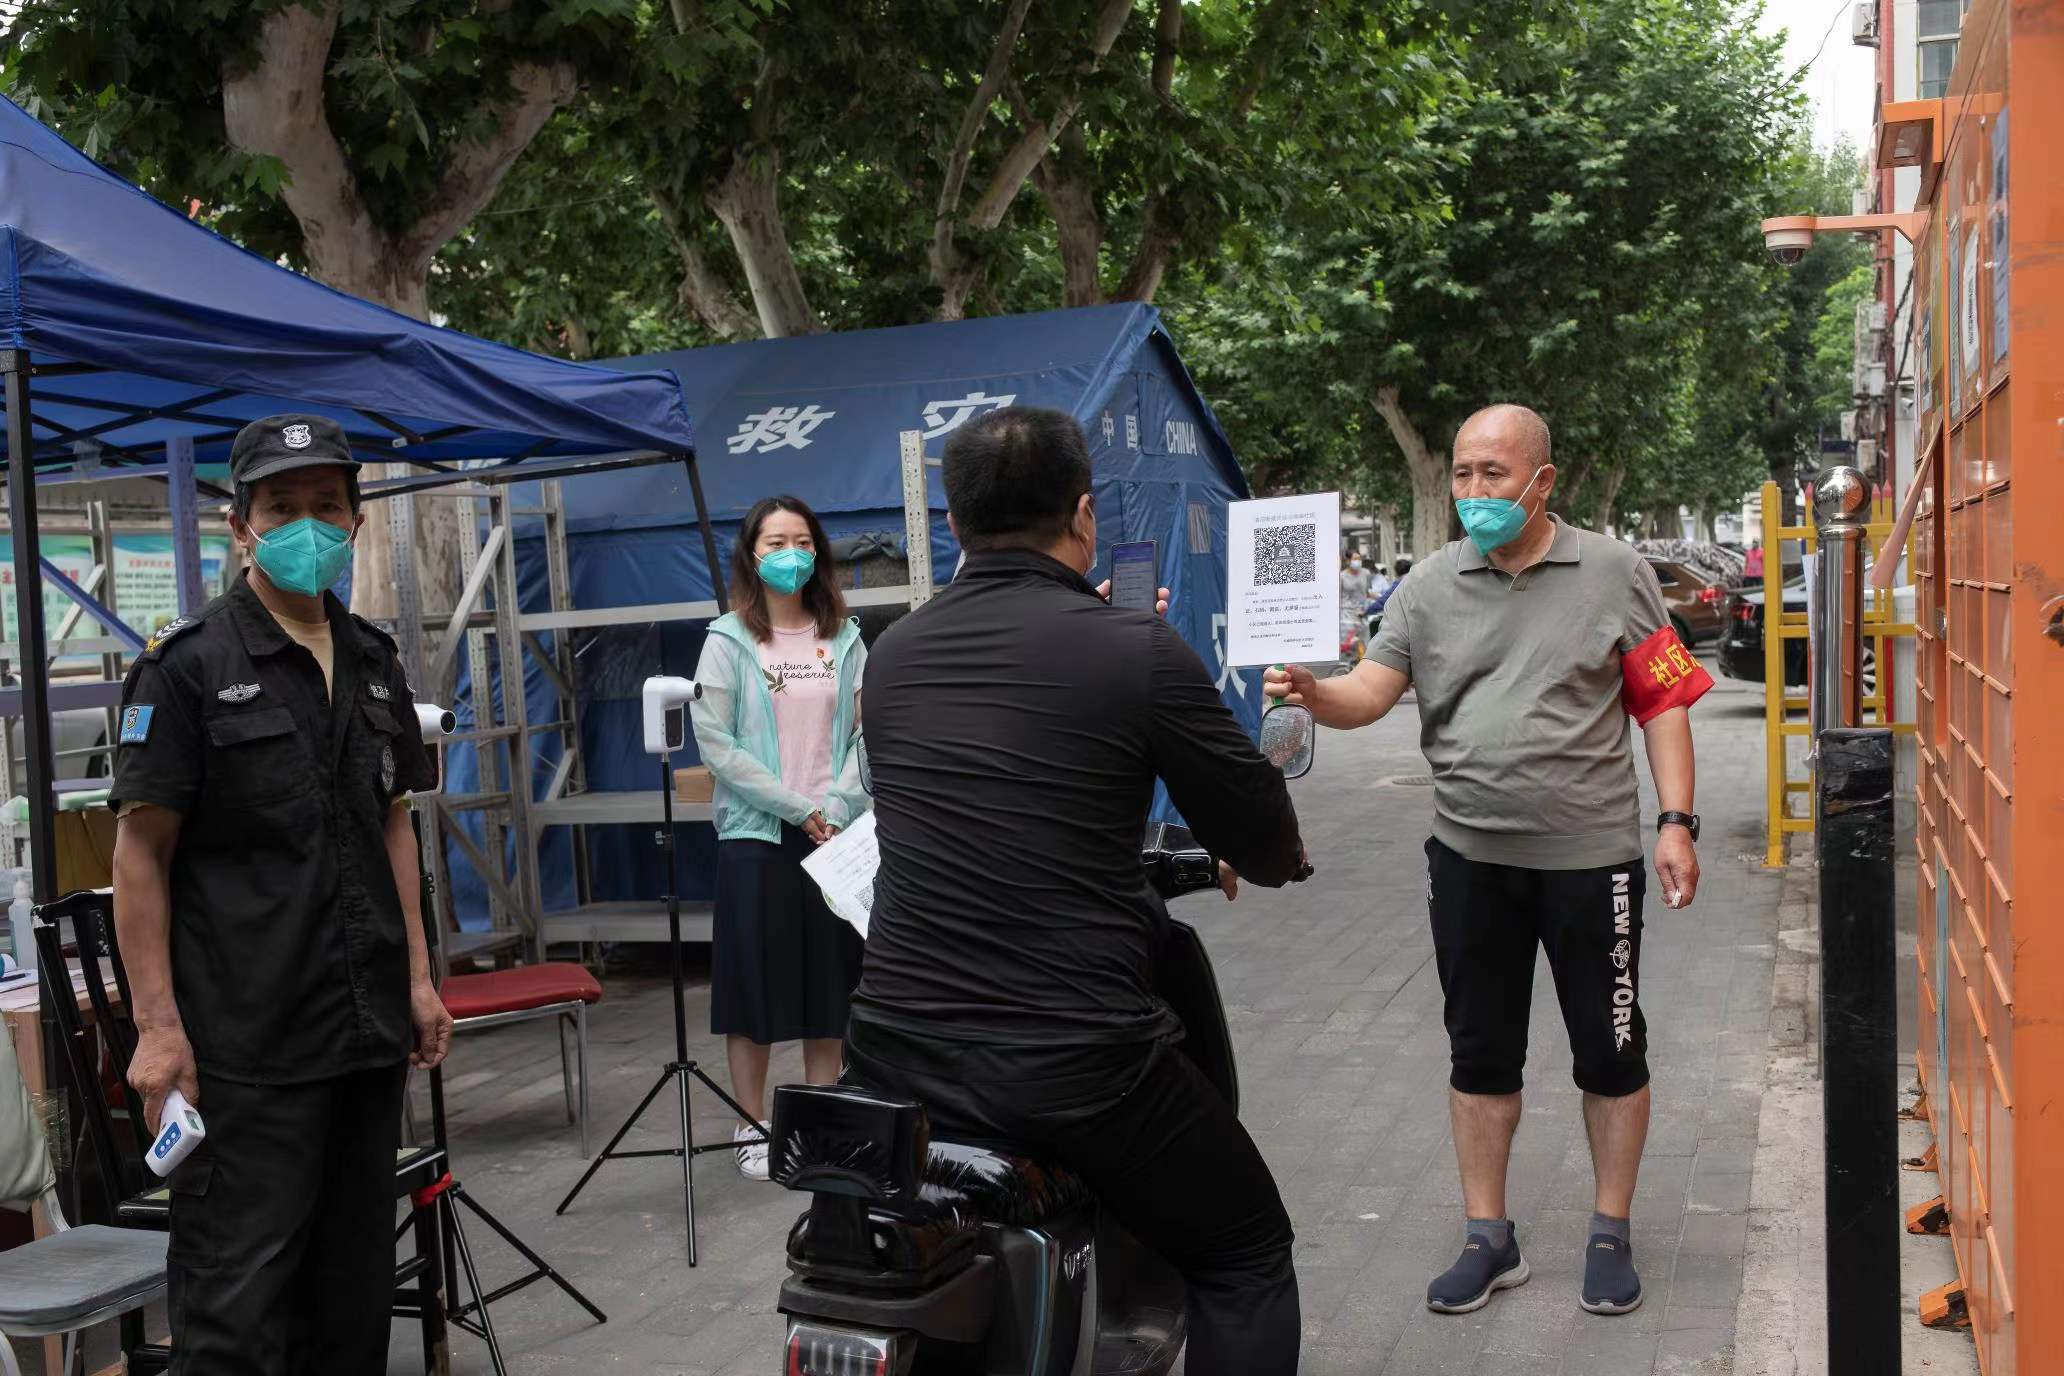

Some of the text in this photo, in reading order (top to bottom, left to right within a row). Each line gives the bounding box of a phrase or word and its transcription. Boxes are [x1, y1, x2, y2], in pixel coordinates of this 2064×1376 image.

[1101, 409, 1198, 457] 中国 CHINA
[769, 660, 813, 671] nature
[783, 671, 835, 680] reserve
[1648, 643, 1702, 689] 社区
[1611, 872, 1635, 1048] NEW YORK
